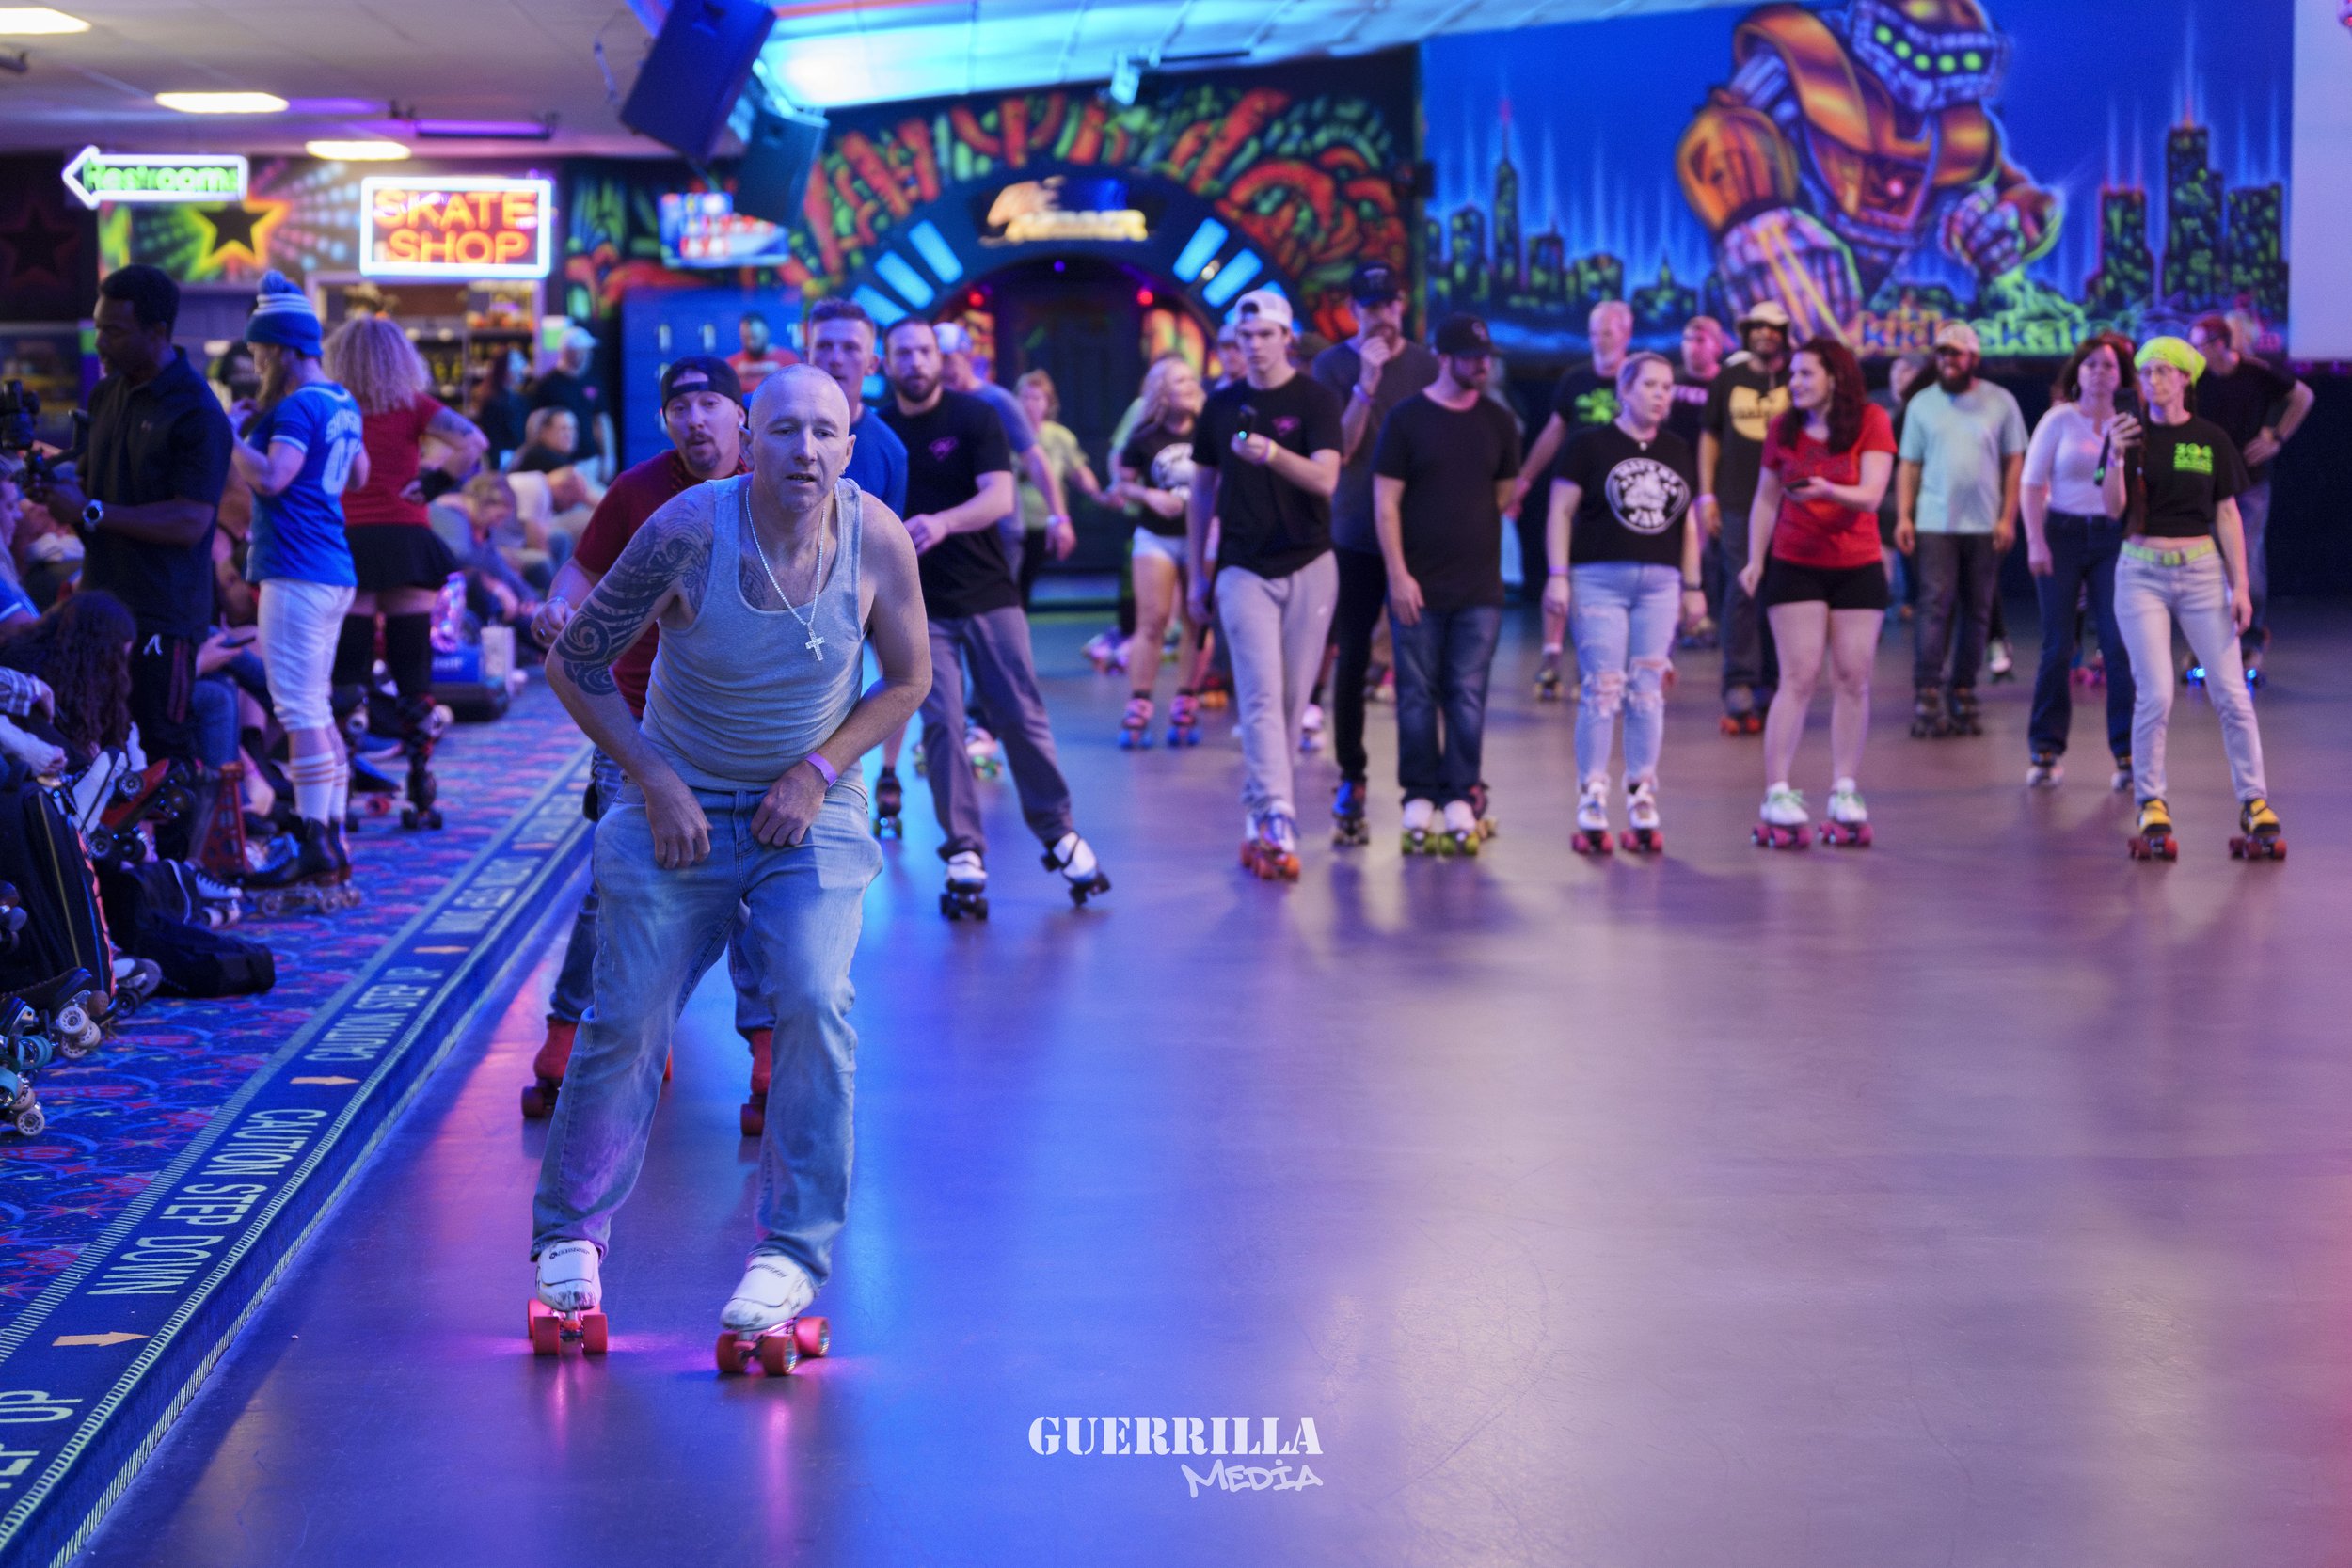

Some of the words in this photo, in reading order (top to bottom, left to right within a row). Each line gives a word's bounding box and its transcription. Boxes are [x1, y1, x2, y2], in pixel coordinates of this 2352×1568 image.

[373, 189, 537, 231] SKATE
[388, 229, 530, 264] SHOP
[352, 984, 430, 1009] STEP
[303, 1013, 408, 1061] CAUTION
[199, 1109, 328, 1176] CAUTION
[159, 1183, 268, 1227] STEP
[86, 1235, 226, 1296] DOWN
